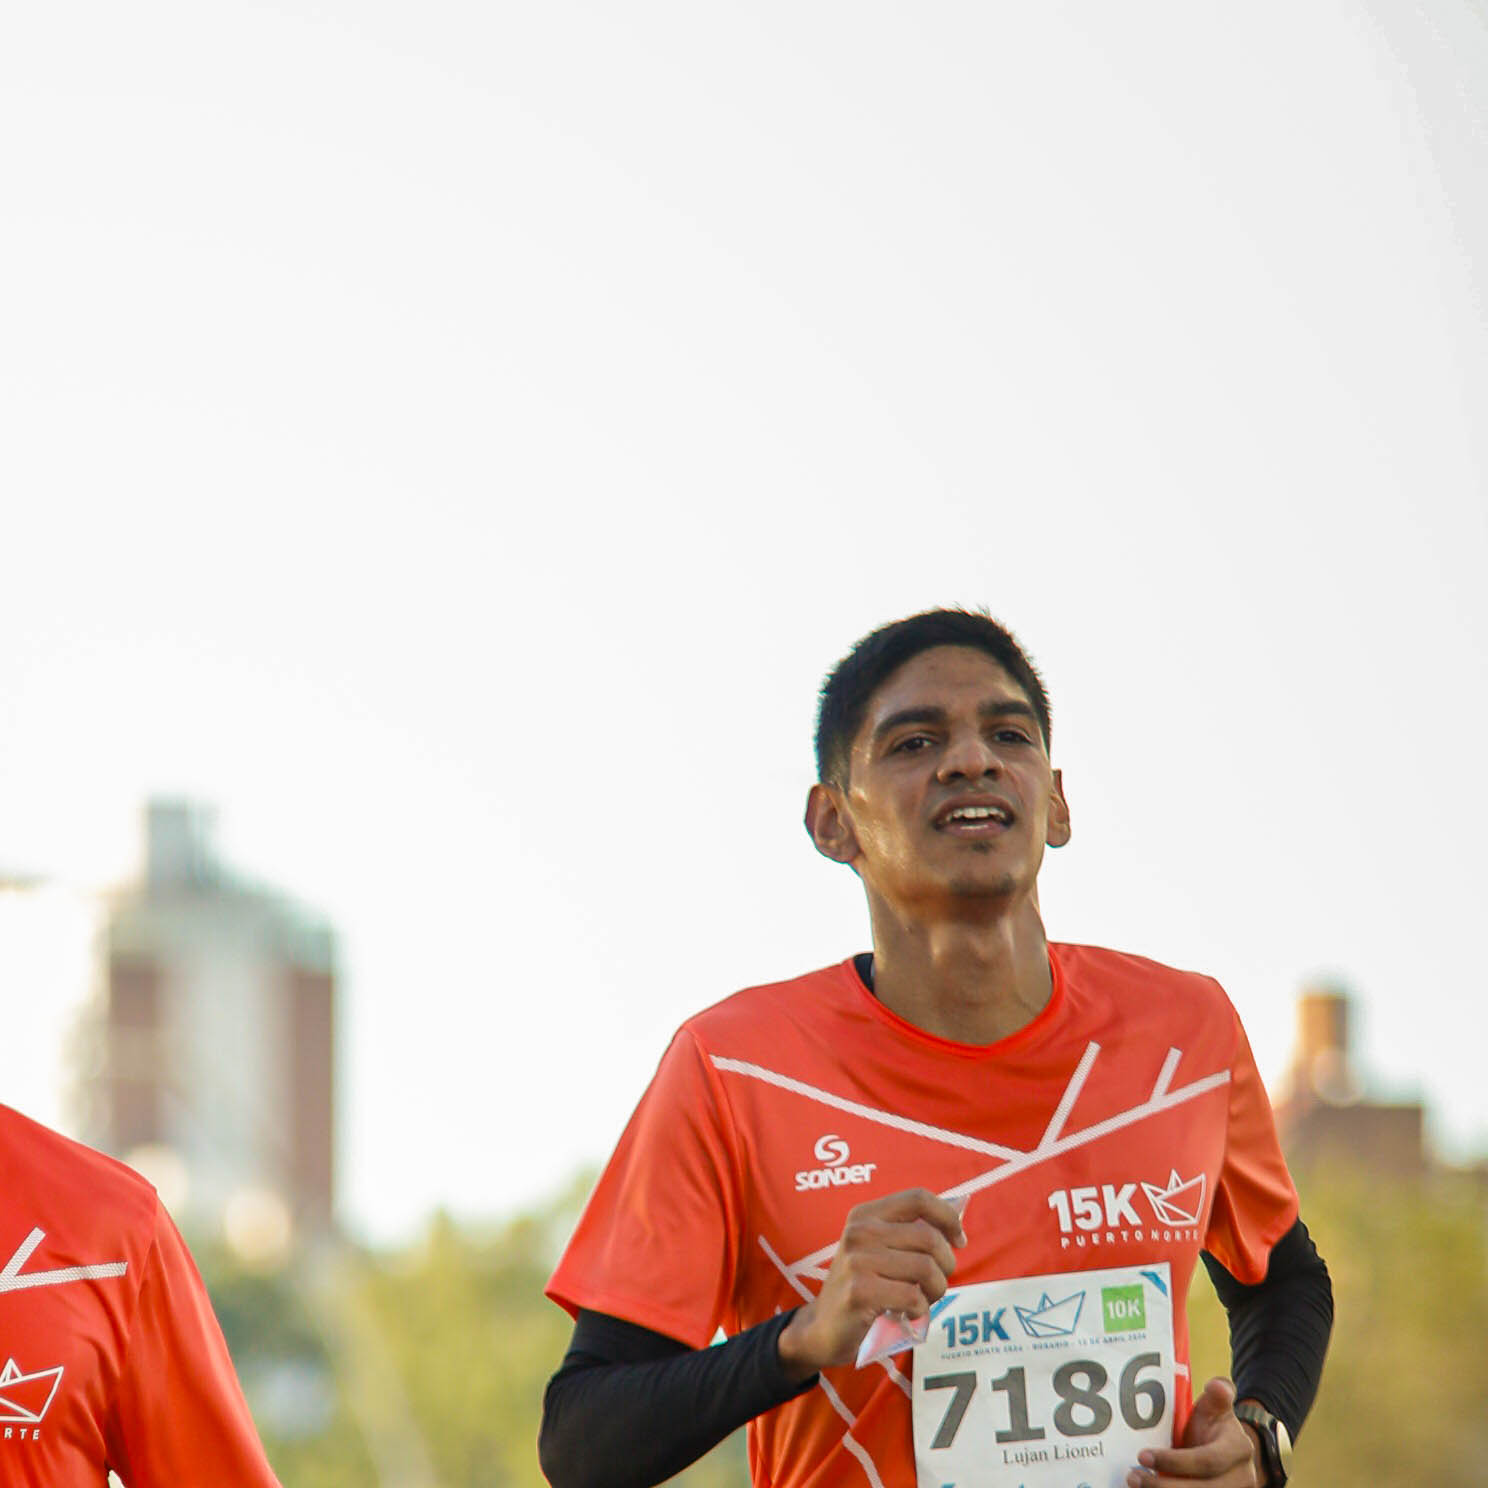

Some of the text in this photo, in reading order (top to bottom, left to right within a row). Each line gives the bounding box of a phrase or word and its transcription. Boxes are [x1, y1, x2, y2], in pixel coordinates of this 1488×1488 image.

[1047, 1183, 1143, 1233] 15K
[1060, 1229, 1199, 1249] PUERTO NORTE
[1107, 1297, 1141, 1319] 10K
[941, 1306, 1010, 1348] 15K
[923, 1352, 1166, 1450] 7186
[1002, 1440, 1105, 1467] Lujan Lionel
